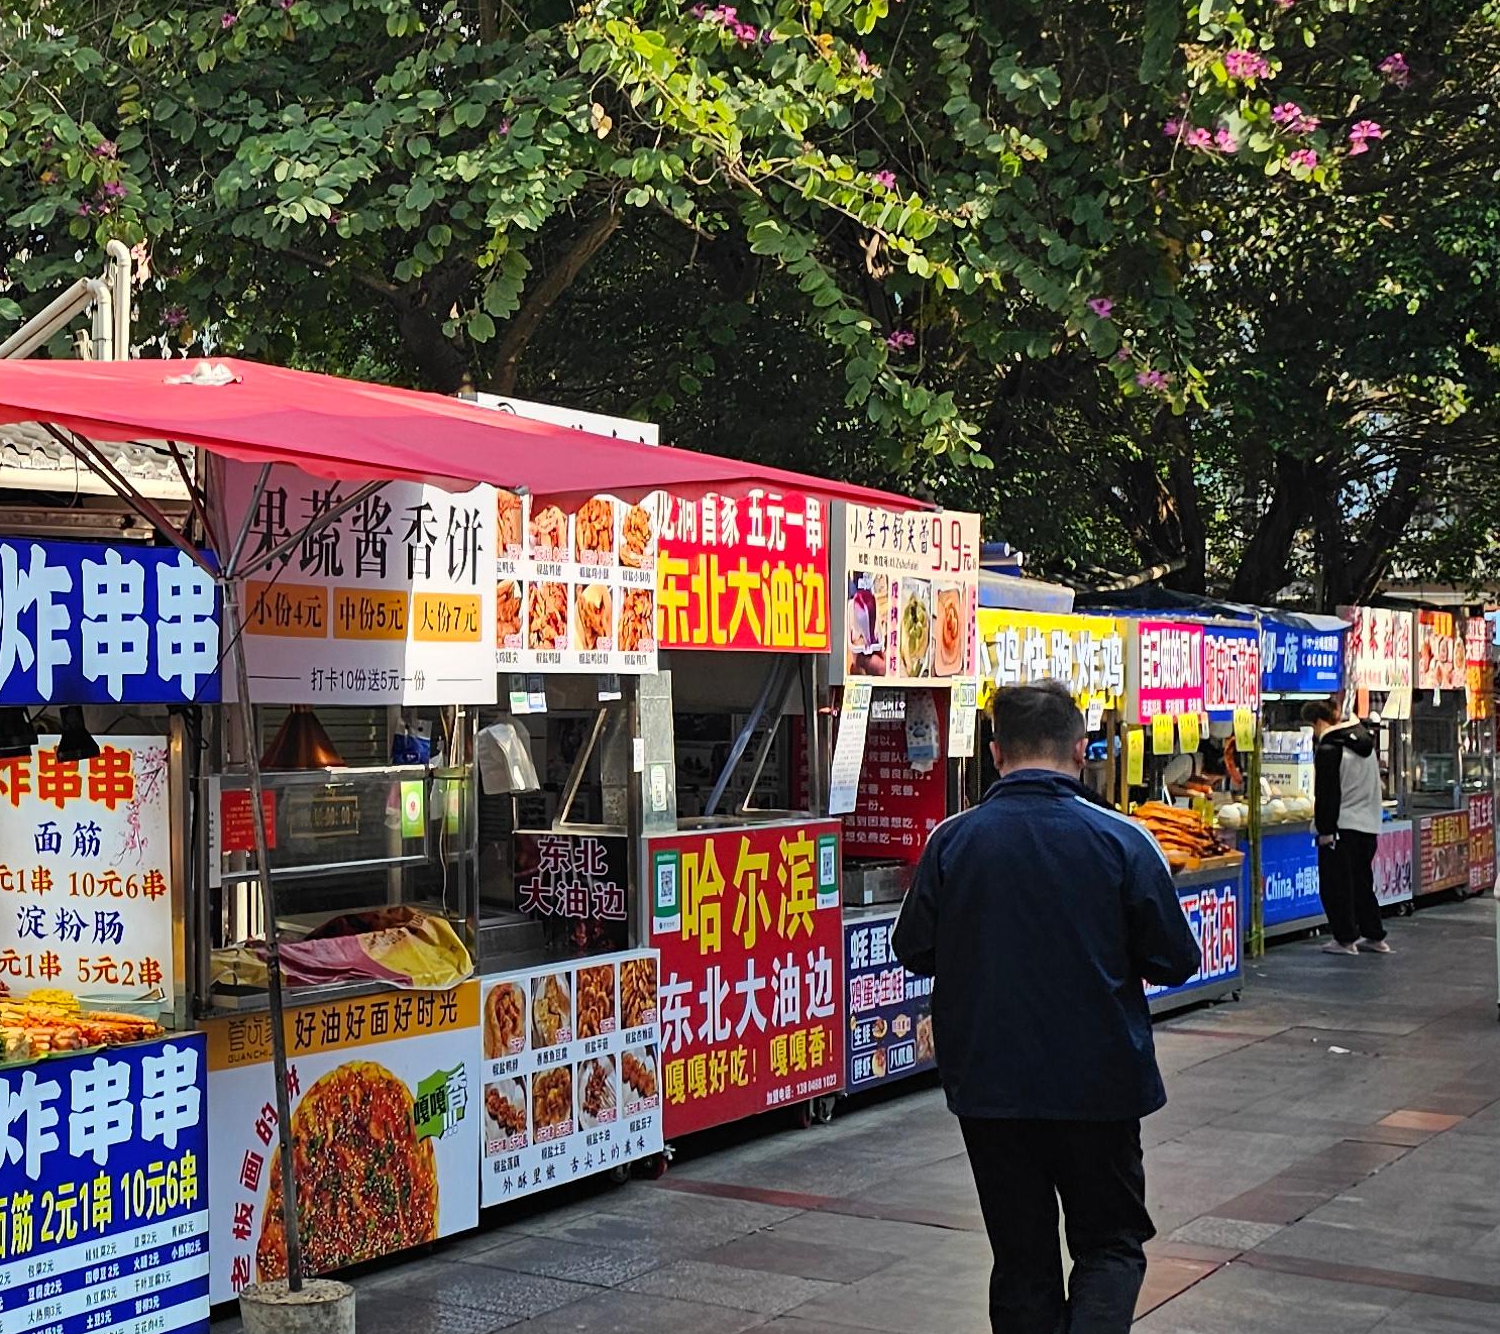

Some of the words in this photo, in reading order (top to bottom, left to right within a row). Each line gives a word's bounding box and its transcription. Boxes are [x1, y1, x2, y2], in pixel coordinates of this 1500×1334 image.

[247, 484, 485, 586] 果蔬酱香饼
[254, 589, 323, 629] 小份4元
[339, 595, 404, 631] 中份5元
[420, 601, 478, 634] 大份7元
[657, 549, 828, 648] 东北大油边
[34, 820, 102, 858] 面筋
[538, 835, 609, 875] 东北
[68, 868, 168, 902] 10元6串
[519, 876, 627, 921] 大油边
[681, 829, 816, 955] 哈尔滨
[16, 905, 125, 945] 淀粉肠
[78, 956, 163, 989] 5元2串
[295, 992, 459, 1051] 好油好面好时光
[660, 946, 835, 1054] 东北大油边
[41, 1170, 114, 1244] 2元1串
[120, 1150, 198, 1222] 10元6串
